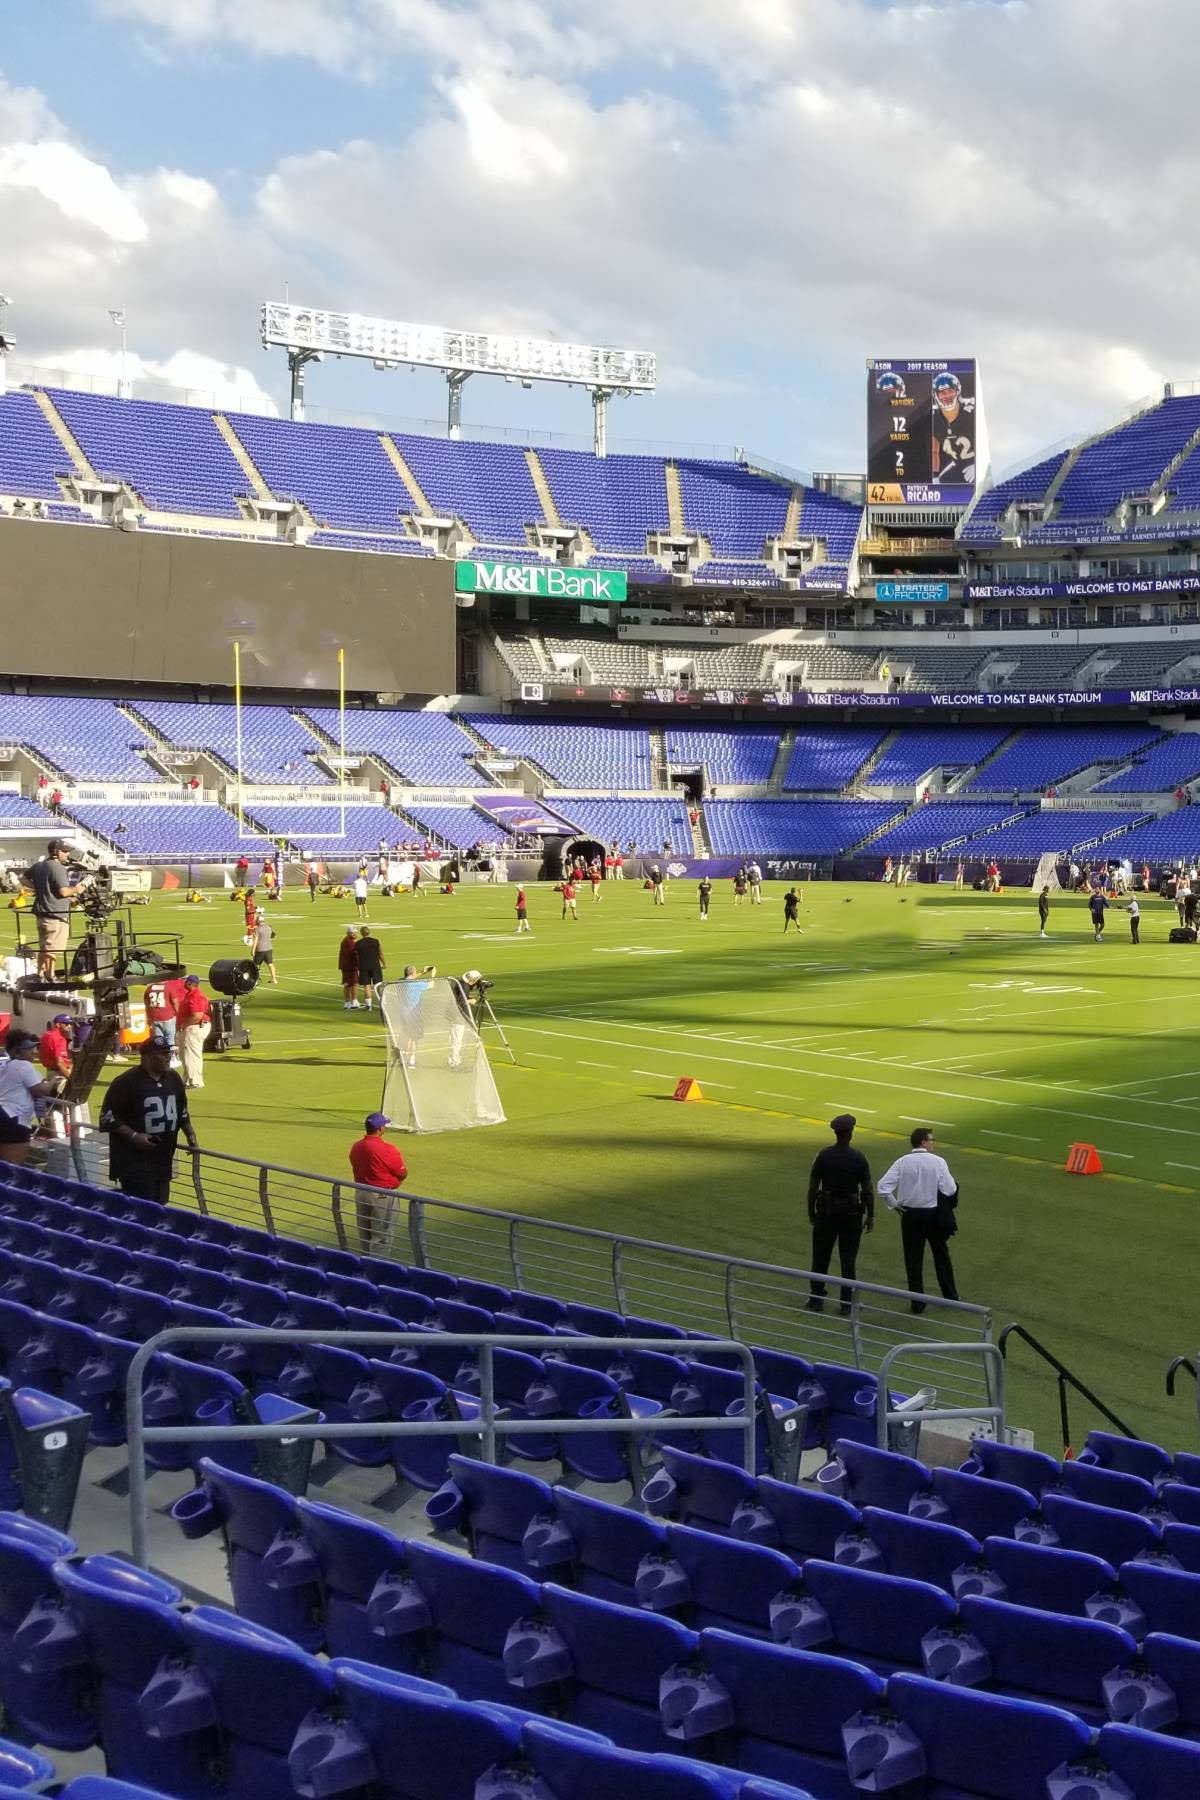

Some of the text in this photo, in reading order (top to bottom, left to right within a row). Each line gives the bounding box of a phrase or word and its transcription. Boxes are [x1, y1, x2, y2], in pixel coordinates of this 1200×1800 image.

[893, 417, 906, 432] 12
[896, 451, 904, 466] 2
[871, 486, 885, 501] 42
[907, 491, 940, 501] RICARD
[473, 562, 612, 599] M&T Bank
[1066, 583, 1114, 594] WELCOME
[1116, 583, 1130, 592] TO
[1132, 581, 1153, 592] M&T
[1155, 579, 1182, 591] BANK
[895, 592, 943, 600] FACTORY
[969, 585, 1053, 597] M&T Bank Stadium
[807, 693, 900, 705] M&T Bank Stadium
[931, 692, 1101, 704] WELCOME TO M&T BANK STADIUM
[1130, 691, 1152, 702] M&T
[1152, 690, 1174, 700] Bank
[144, 1094, 178, 1134] 24
[1072, 1148, 1088, 1171] 10
